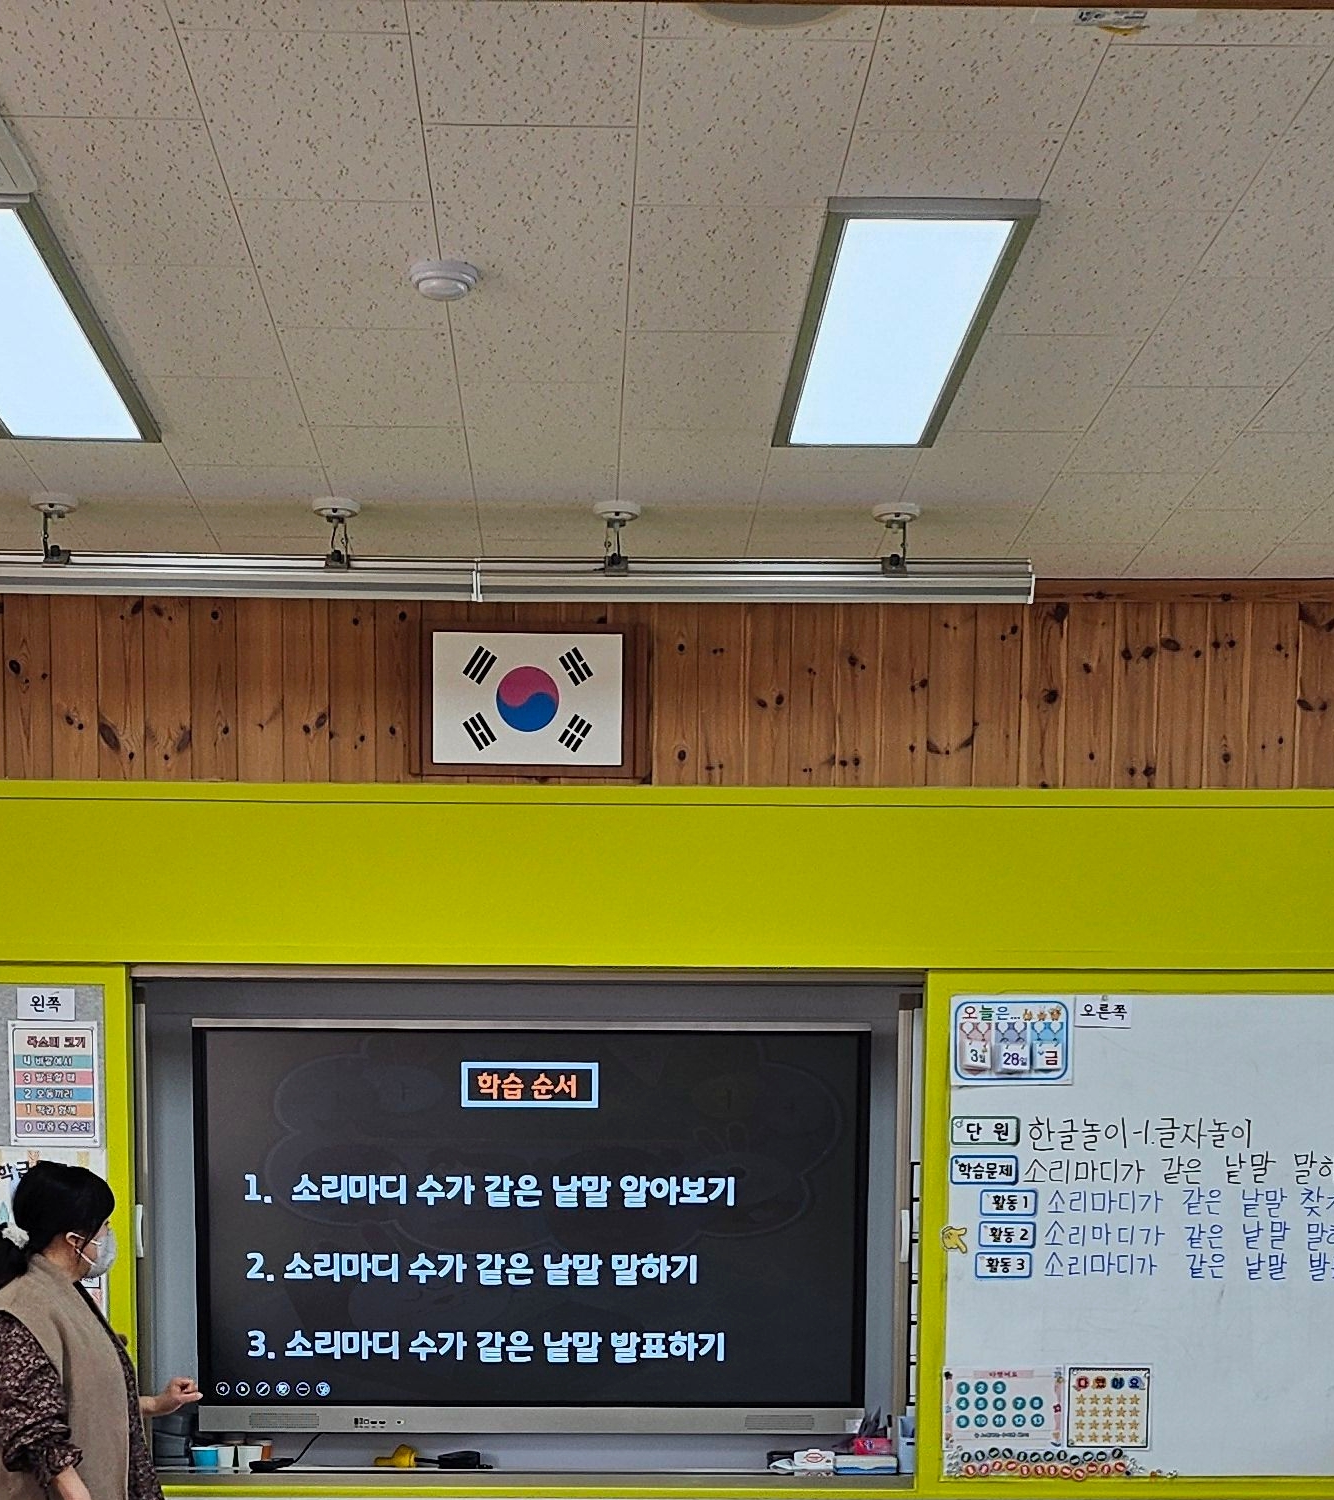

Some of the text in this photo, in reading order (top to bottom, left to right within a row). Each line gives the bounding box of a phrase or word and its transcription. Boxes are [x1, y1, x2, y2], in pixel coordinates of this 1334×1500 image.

[30, 995, 61, 1013] 왼쪽
[1079, 1003, 1128, 1021] 오른쪽
[23, 1055, 31, 1066] 4
[970, 1049, 986, 1063] 3월
[1003, 1052, 1028, 1066] 28일
[1045, 1051, 1058, 1066] 금
[23, 1073, 31, 1083] 3
[476, 1072, 577, 1100] 학습 순서
[24, 1089, 31, 1099] 2
[26, 1104, 31, 1114] 1
[25, 1121, 32, 1132] 0
[958, 1163, 1012, 1180] 학습문제
[1023, 1158, 1145, 1184] 소리마디가
[1161, 1156, 1202, 1185] 같은
[1225, 1151, 1277, 1184] 낱말
[244, 1174, 736, 1208] 1. 소리마디 수가 같은 낱말 알아보기
[992, 1195, 1028, 1211] 활동 1
[1047, 1190, 1164, 1214] 소리마디가
[1182, 1187, 1221, 1215] 같은
[1242, 1187, 1288, 1217] 낱말
[988, 1227, 1029, 1243] 활동 2
[1044, 1220, 1165, 1246] 소리마디가
[1185, 1223, 1224, 1250] 같은
[1242, 1220, 1290, 1250] 낱말
[246, 1252, 699, 1286] 2. 소리마디 수가 같은 낱말 말하기
[985, 1257, 1025, 1274] 활동 3
[1044, 1252, 1157, 1277] 소리마디가
[1186, 1253, 1225, 1279] 같은
[1246, 1253, 1288, 1280] 낱말
[247, 1330, 725, 1364] 3. 소리마디 수가 같은 낱말 발표하기
